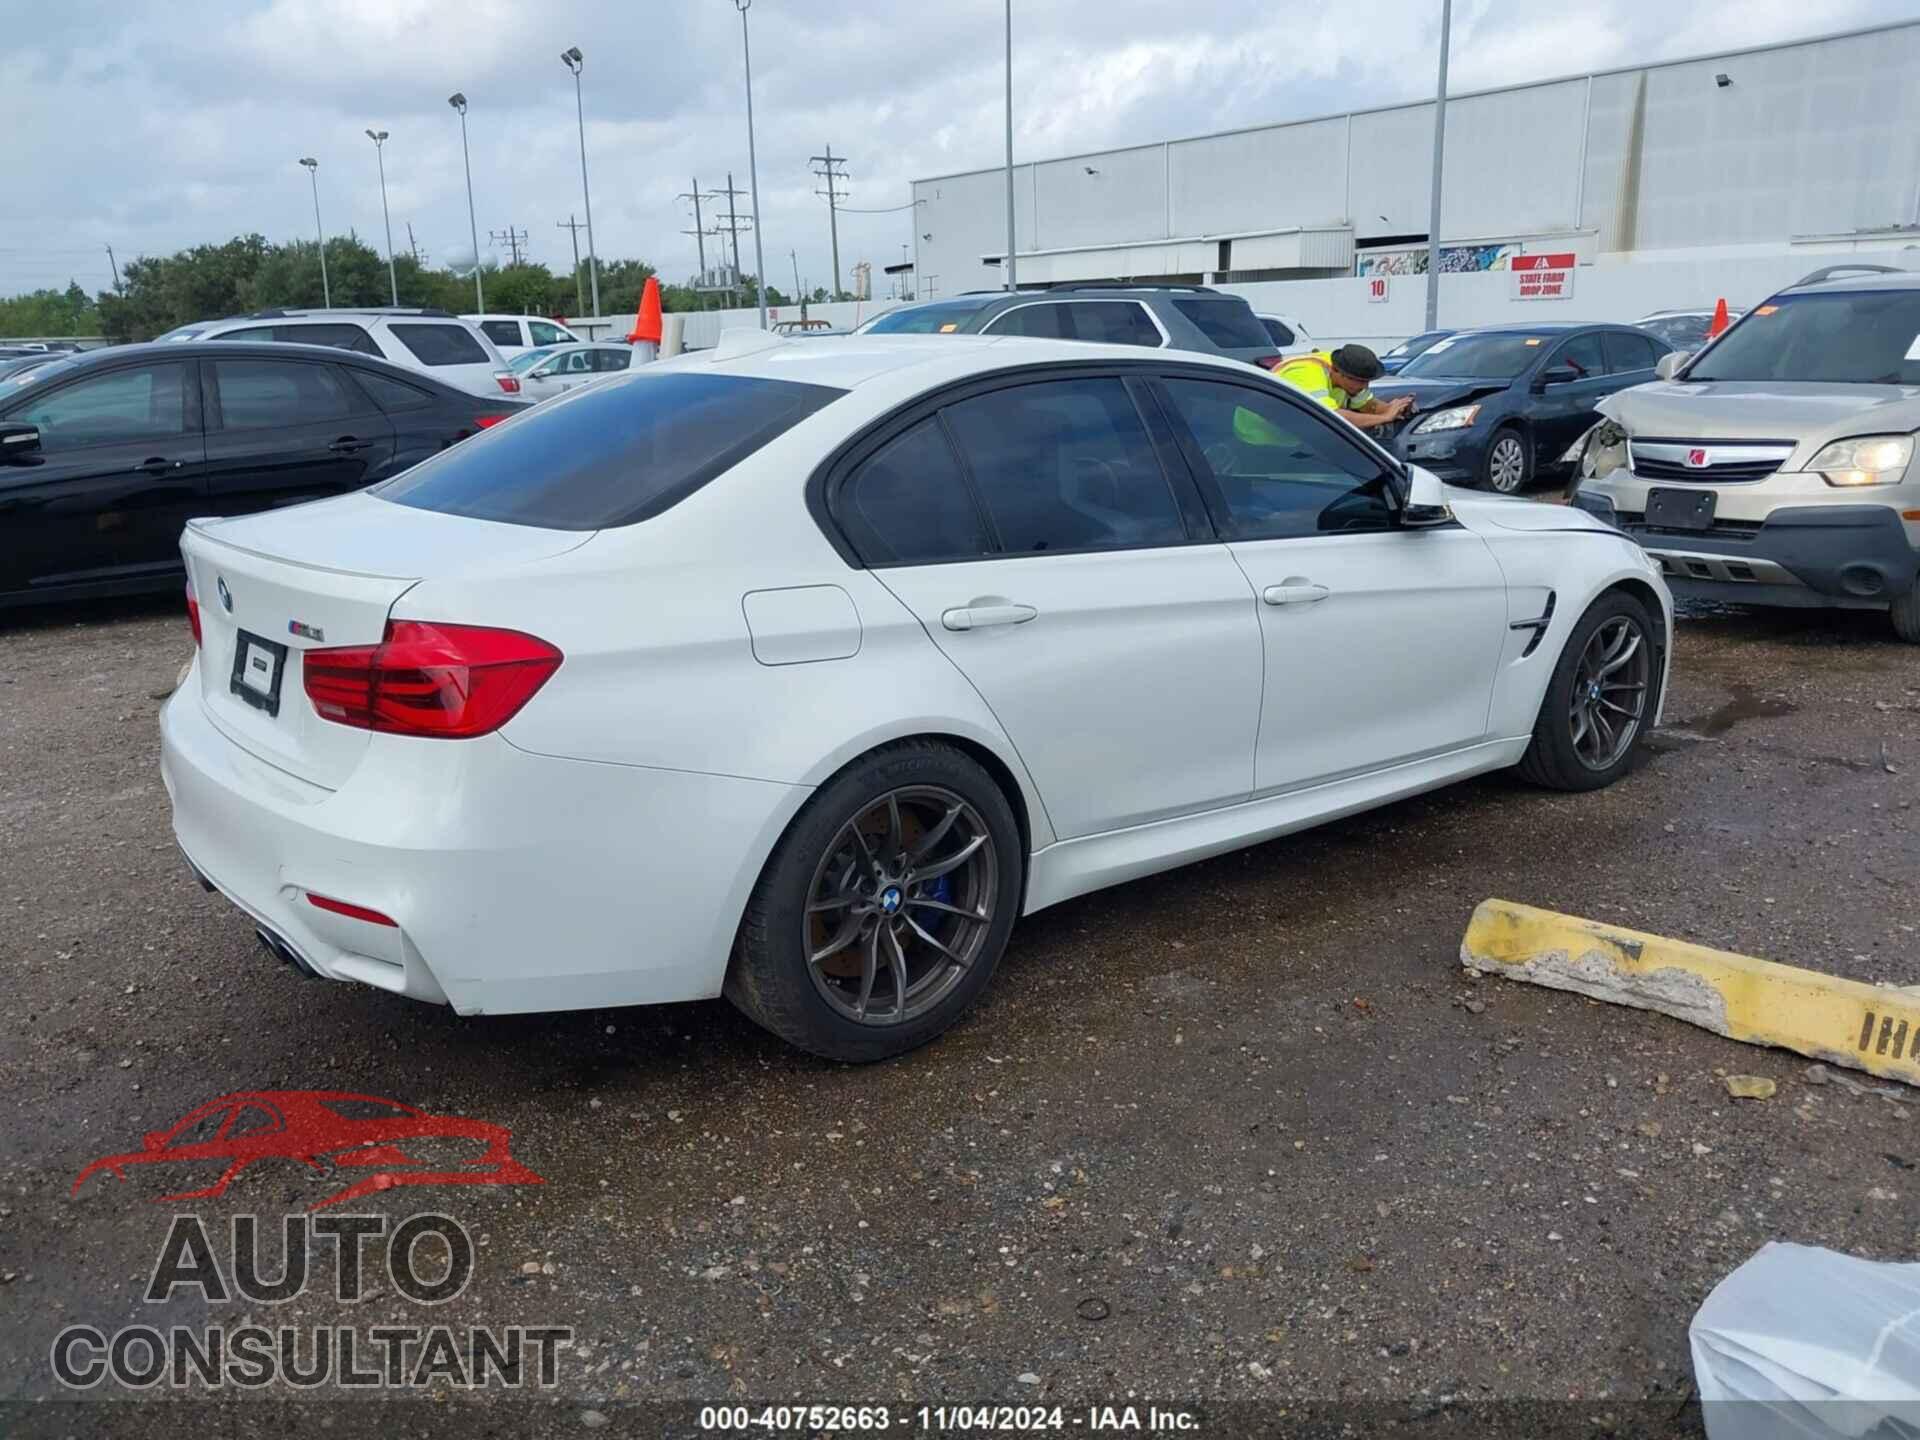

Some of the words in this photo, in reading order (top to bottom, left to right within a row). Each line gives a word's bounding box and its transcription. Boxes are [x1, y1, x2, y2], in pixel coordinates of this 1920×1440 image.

[1519, 273, 1541, 284] STATE
[1542, 272, 1565, 283] FARM
[1371, 279, 1385, 297] 10
[1519, 285, 1542, 296] DROP
[1540, 284, 1562, 295] ZONE
